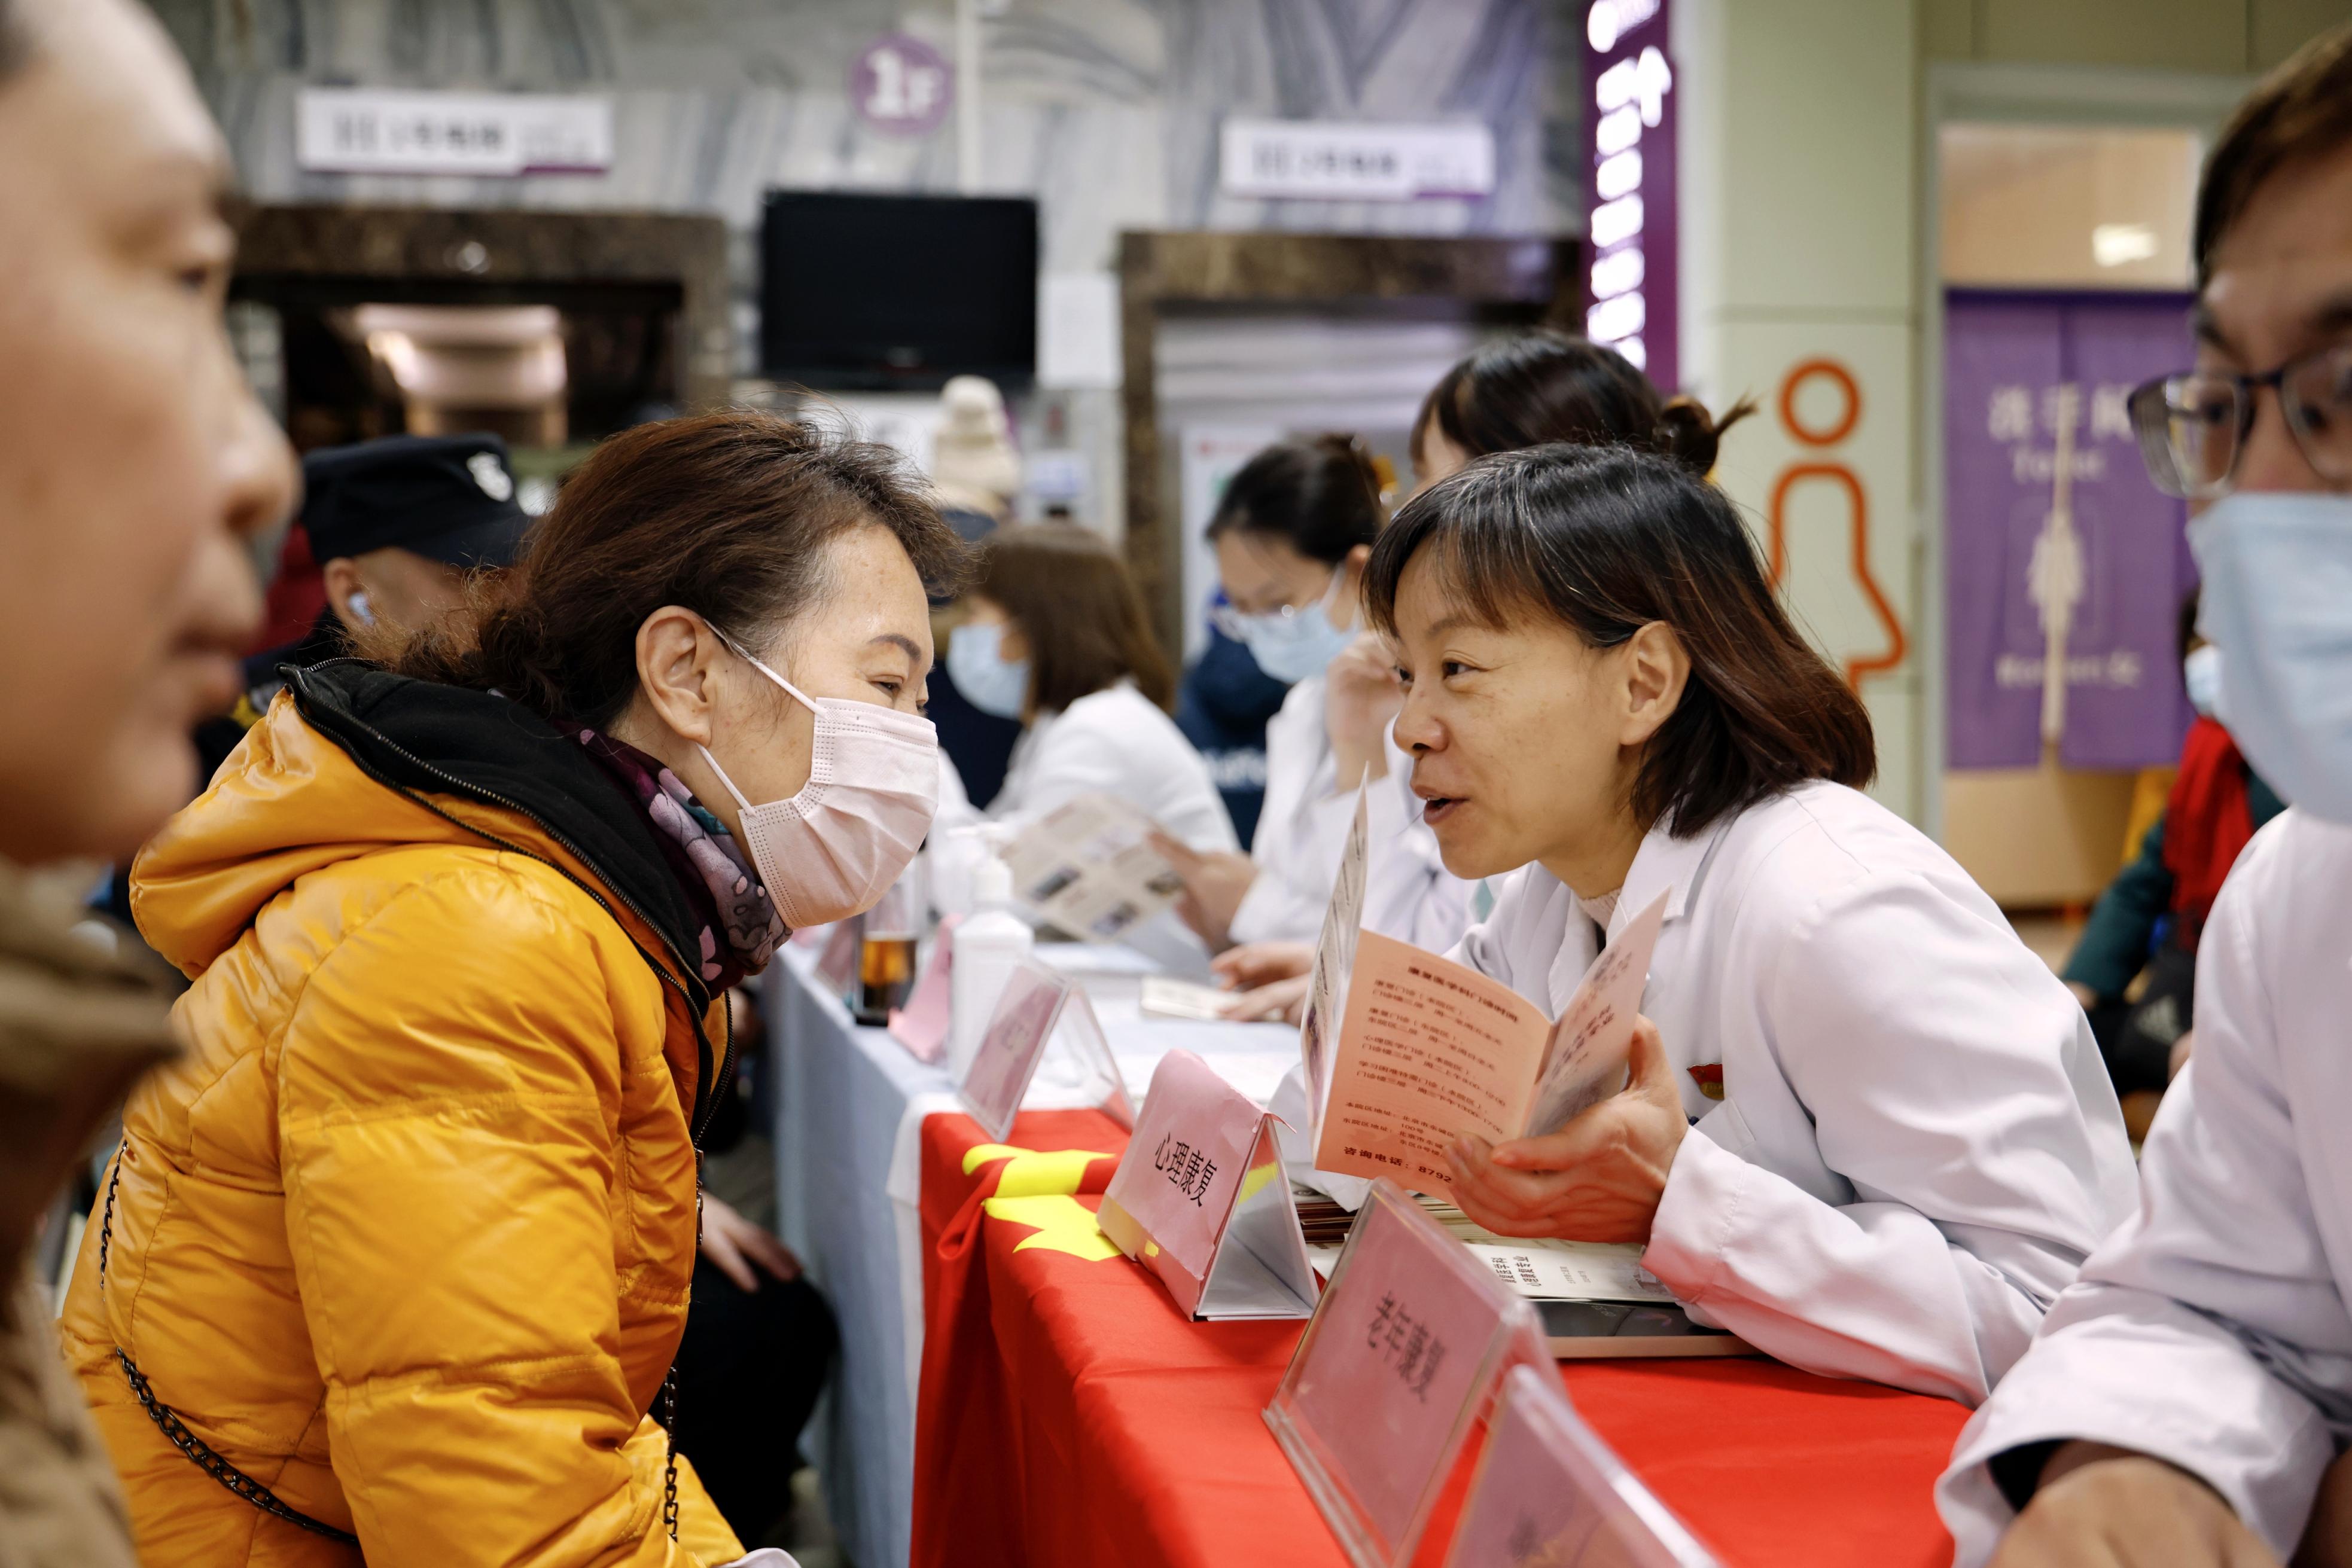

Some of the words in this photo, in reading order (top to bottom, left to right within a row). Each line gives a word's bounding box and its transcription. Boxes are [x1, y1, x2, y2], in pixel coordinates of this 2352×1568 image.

[1154, 1131, 1217, 1208] 心理康复
[1513, 1256, 1542, 1287] 心理康复专业
